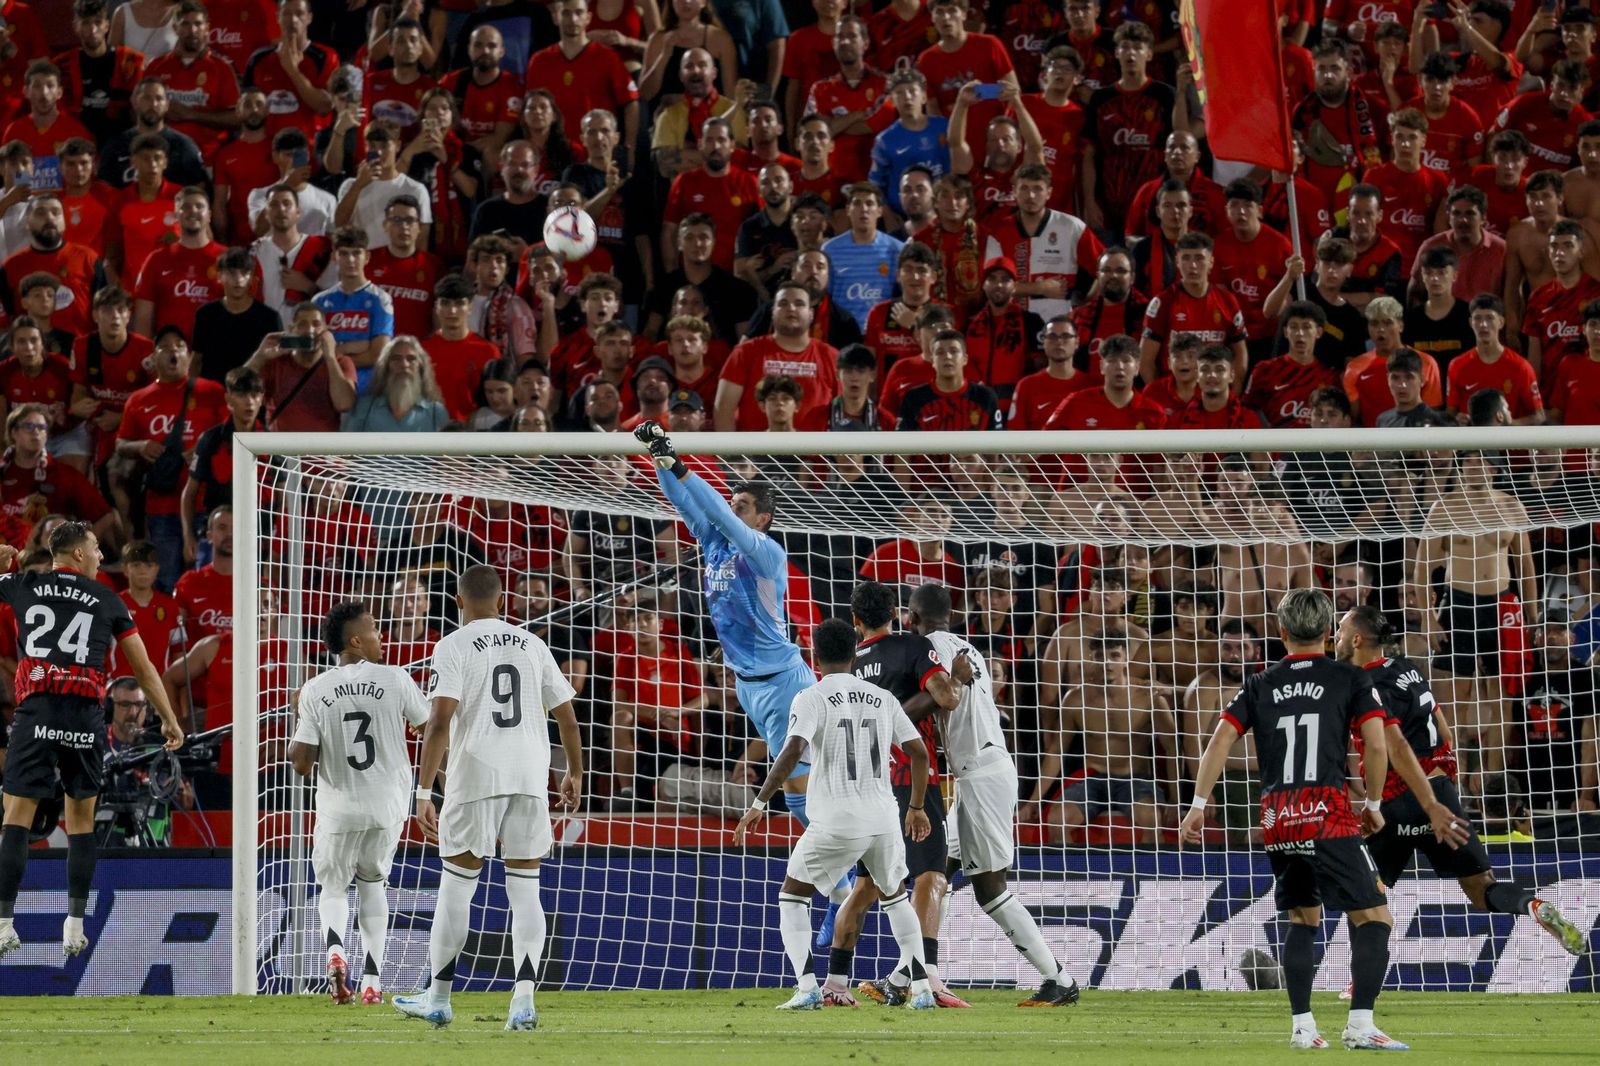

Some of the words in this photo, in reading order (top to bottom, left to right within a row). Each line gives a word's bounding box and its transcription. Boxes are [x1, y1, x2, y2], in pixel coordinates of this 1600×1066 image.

[33, 584, 100, 608] VALJENT
[25, 604, 94, 665] 24
[472, 633, 529, 653] MAPPÉ
[855, 662, 881, 680] AMU
[321, 695, 335, 708] E.
[334, 680, 385, 700] MILITÃO
[491, 663, 522, 728] 9
[828, 691, 883, 709] RORYGO
[1272, 681, 1325, 704] ASANO
[1419, 691, 1438, 748] 7
[34, 725, 95, 744] Menorca
[343, 710, 376, 772] 3
[837, 718, 882, 781] 11
[1276, 713, 1320, 784] 11
[1278, 800, 1329, 819] ALUA
